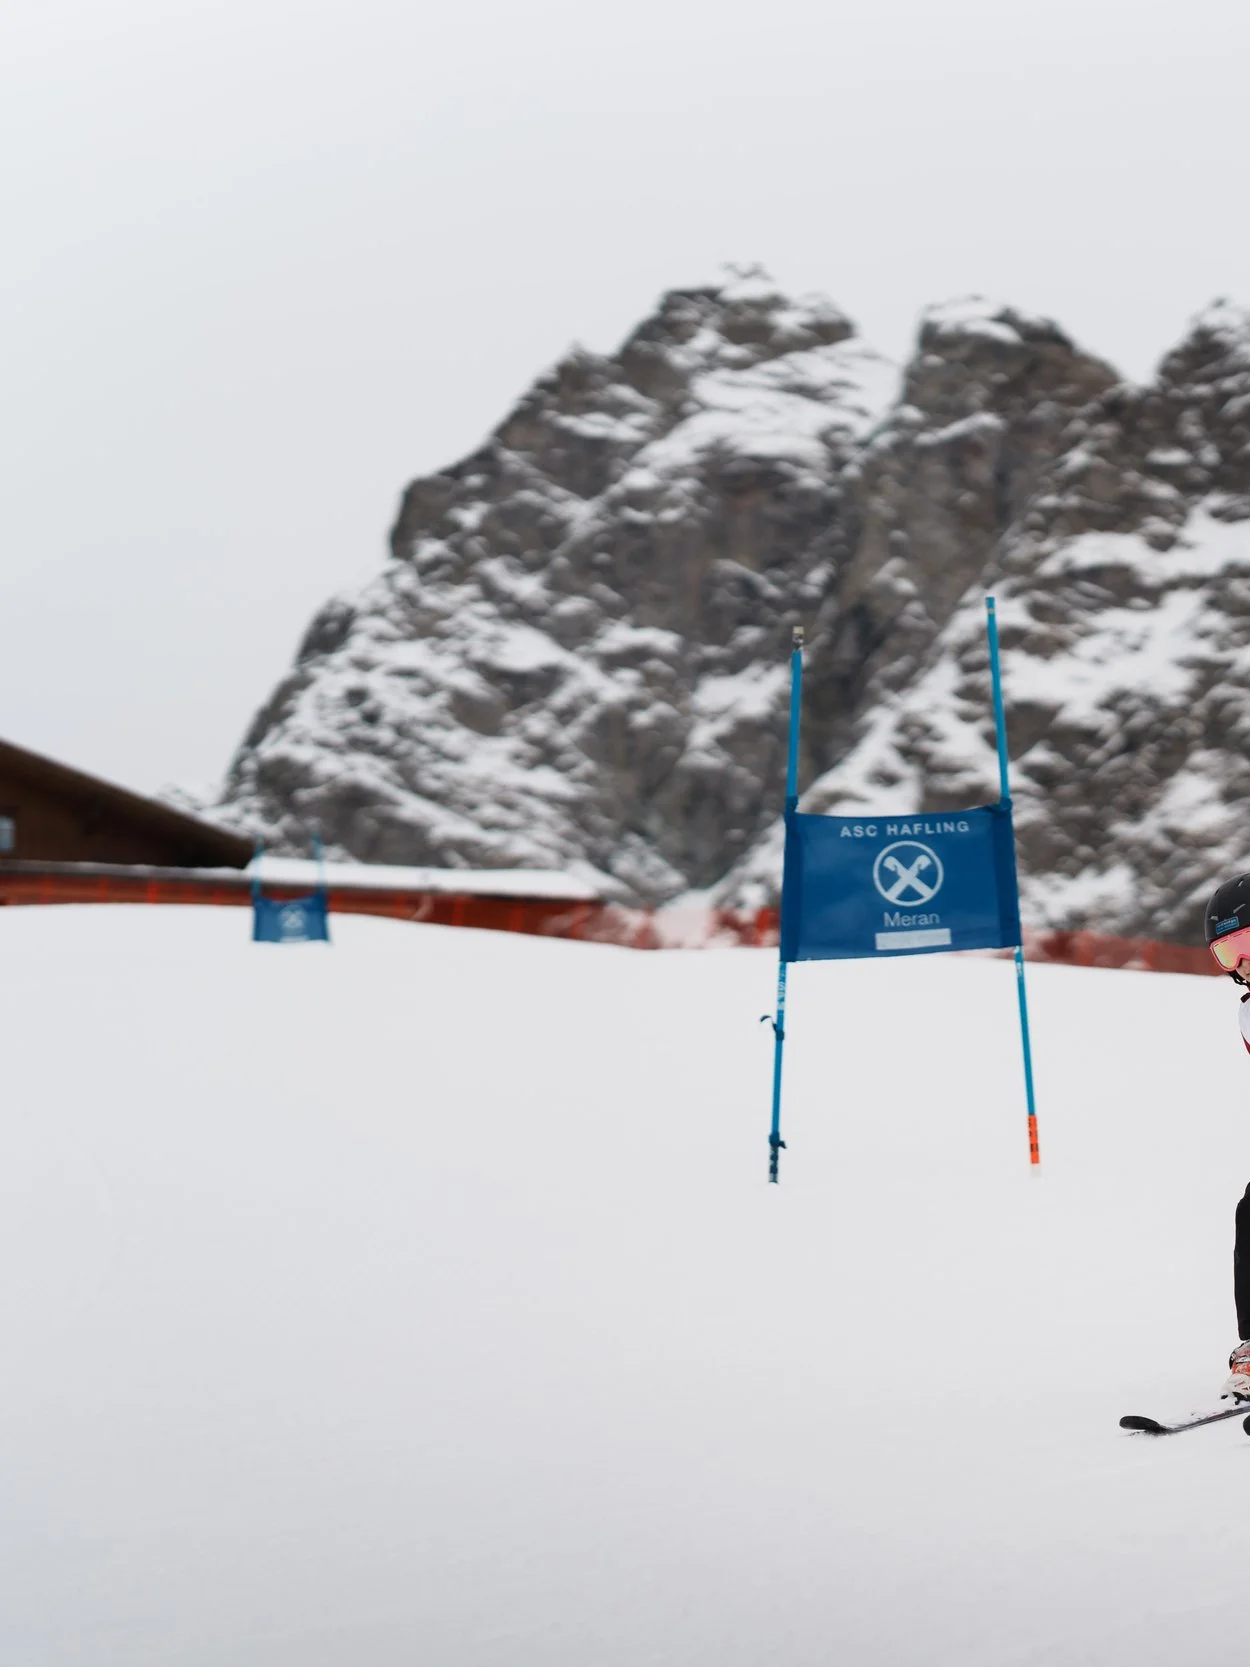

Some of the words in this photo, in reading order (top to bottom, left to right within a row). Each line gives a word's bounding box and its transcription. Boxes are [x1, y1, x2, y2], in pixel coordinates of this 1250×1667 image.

[840, 825, 878, 838] ASC
[886, 821, 970, 836] HAFLING
[883, 911, 940, 927] Meran
